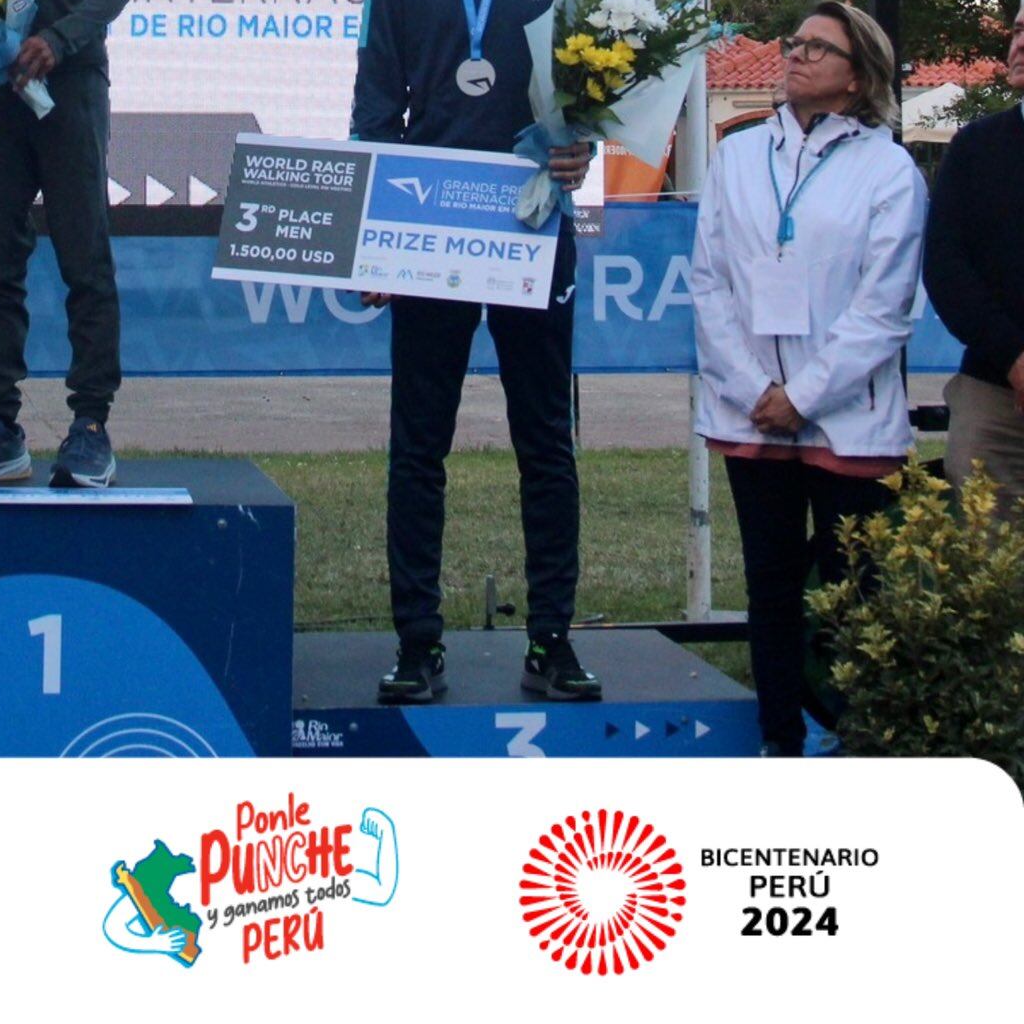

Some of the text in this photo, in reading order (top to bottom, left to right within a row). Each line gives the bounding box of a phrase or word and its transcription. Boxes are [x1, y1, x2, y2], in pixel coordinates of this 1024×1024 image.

[130, 14, 360, 38] DE RIO MAIOR E
[245, 154, 356, 176] WORLD RACE
[242, 167, 355, 187] WALKING TOUR
[442, 178, 497, 194] GRANDE
[278, 208, 334, 226] PLACE
[275, 224, 313, 241] MEN
[228, 243, 335, 265] 1.500,00 USD
[362, 229, 542, 263] PRIZE MONEY
[28, 613, 63, 695] 1
